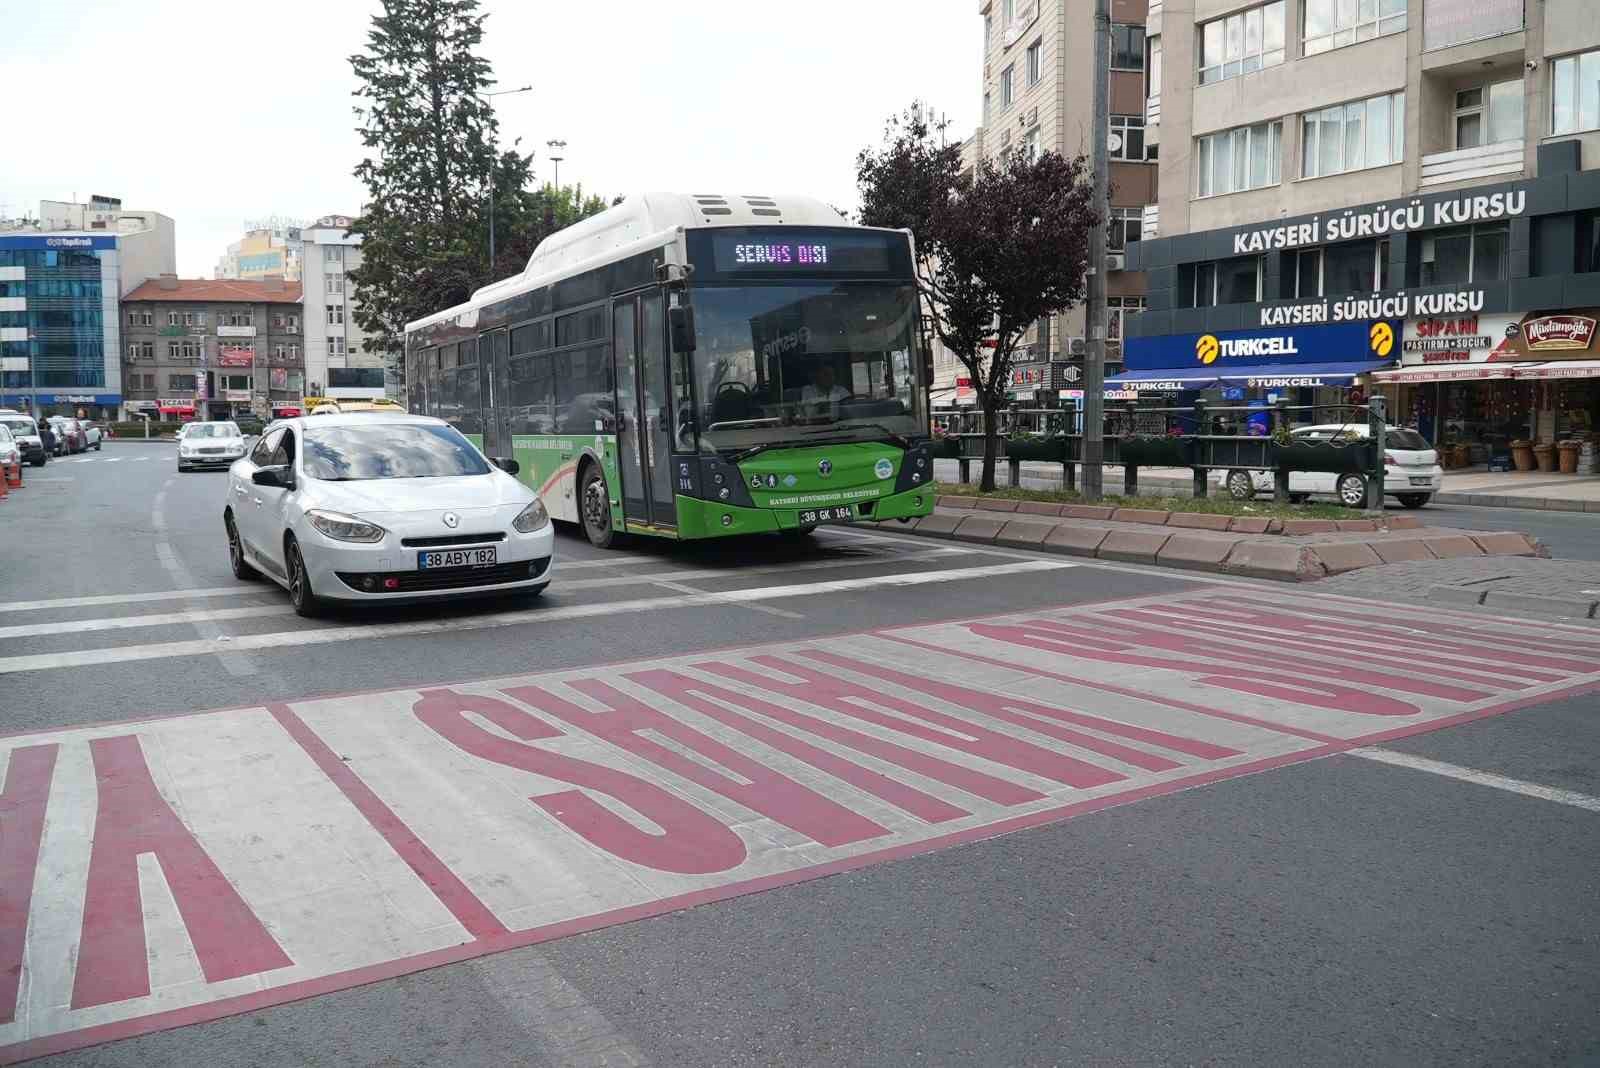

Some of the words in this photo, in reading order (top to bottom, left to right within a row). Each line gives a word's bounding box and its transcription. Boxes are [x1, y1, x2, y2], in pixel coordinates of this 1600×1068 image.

[1234, 216, 1320, 254] KAYSERİ
[1326, 200, 1425, 241] SÜRÜCÜ
[1434, 190, 1527, 225] KURSU
[1261, 300, 1328, 326] KAYSERİ
[1333, 291, 1408, 321] SÜRÜCÜ
[1415, 290, 1485, 315] KURSU
[1219, 337, 1298, 357] TURKCELL
[1407, 340, 1450, 351] PASTIRMA
[1456, 338, 1486, 348] SUCUK
[1130, 382, 1184, 390] TURKCELL
[1256, 378, 1324, 386] TURKCELL
[805, 511, 817, 522] 38
[820, 510, 832, 520] GK
[836, 507, 851, 518] 164
[427, 554, 442, 567] 38
[445, 552, 472, 564] ABY
[475, 550, 494, 562] 182
